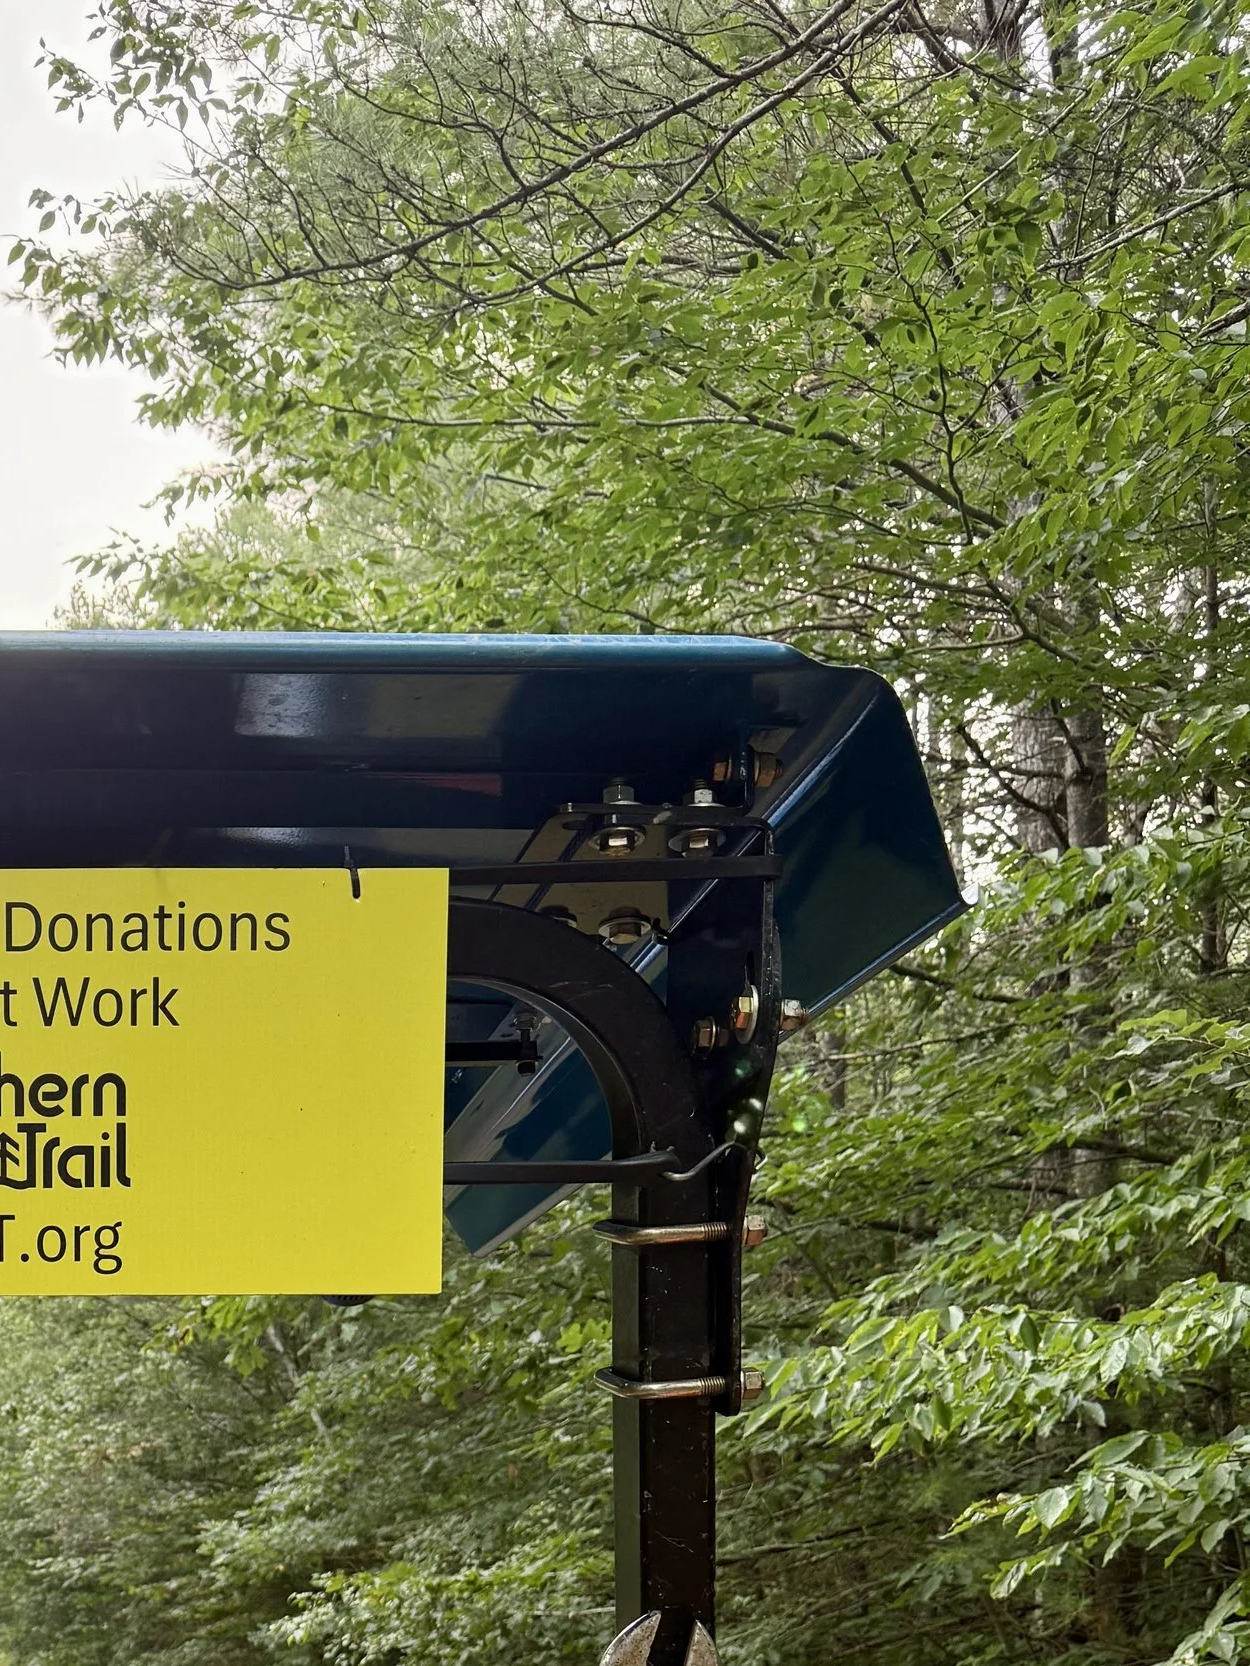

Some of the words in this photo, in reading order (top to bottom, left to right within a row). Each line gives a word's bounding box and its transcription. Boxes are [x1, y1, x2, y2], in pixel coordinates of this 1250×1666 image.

[5, 900, 291, 953] Donations
[32, 976, 180, 1028] Work
[17, 1121, 131, 1190] Trail
